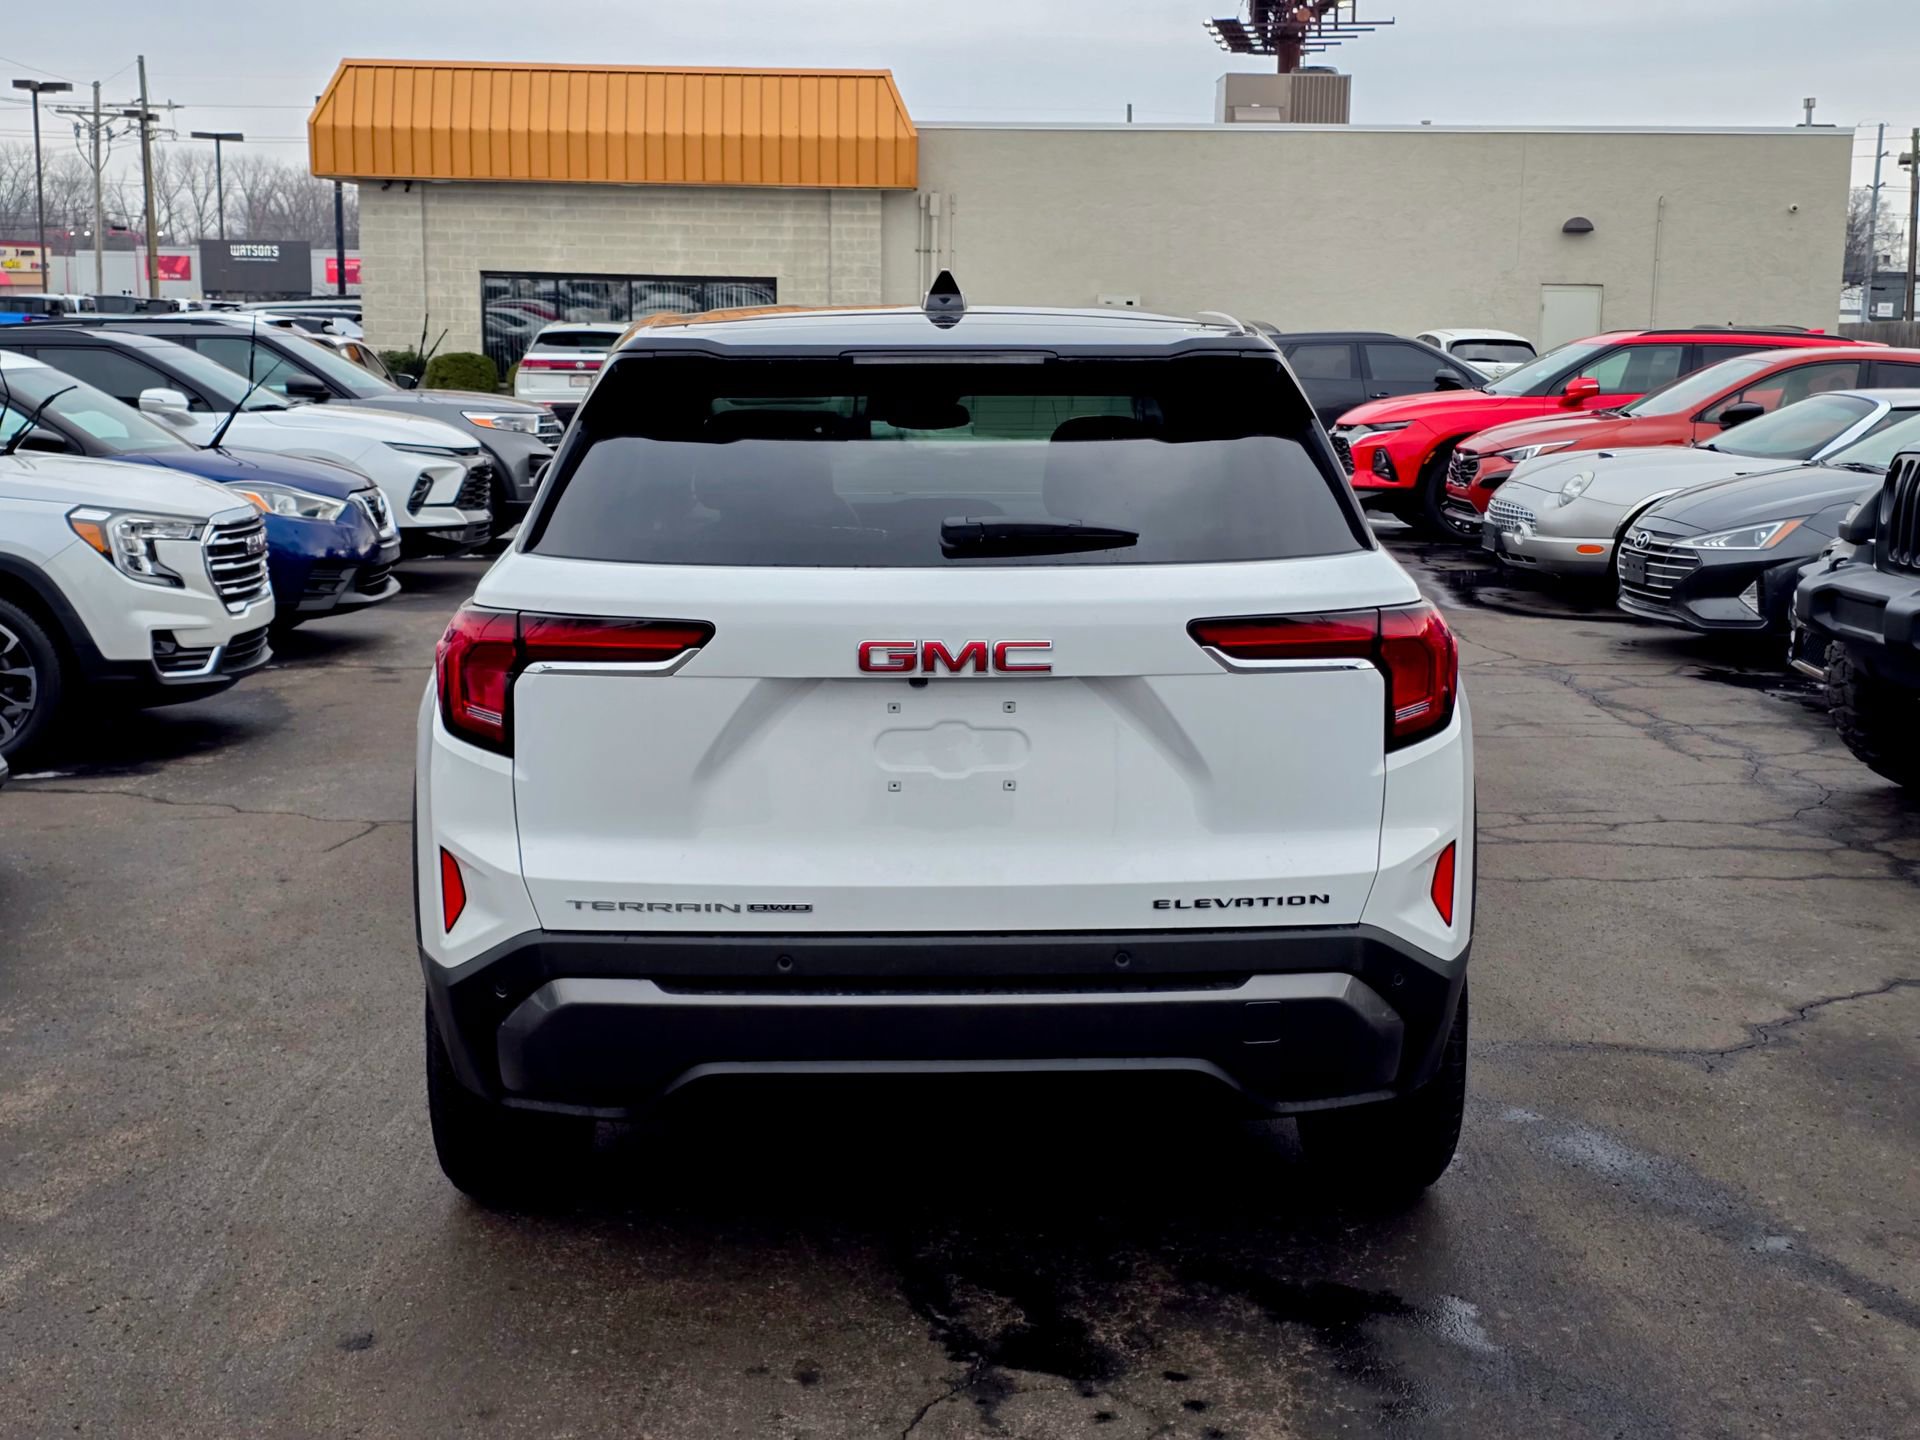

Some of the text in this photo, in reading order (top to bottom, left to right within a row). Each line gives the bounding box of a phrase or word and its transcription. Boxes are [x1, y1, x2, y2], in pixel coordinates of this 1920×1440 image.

[857, 639, 1053, 674] GMC
[566, 900, 813, 913] TERRAIN AWD
[1152, 894, 1330, 910] ELEVATION
